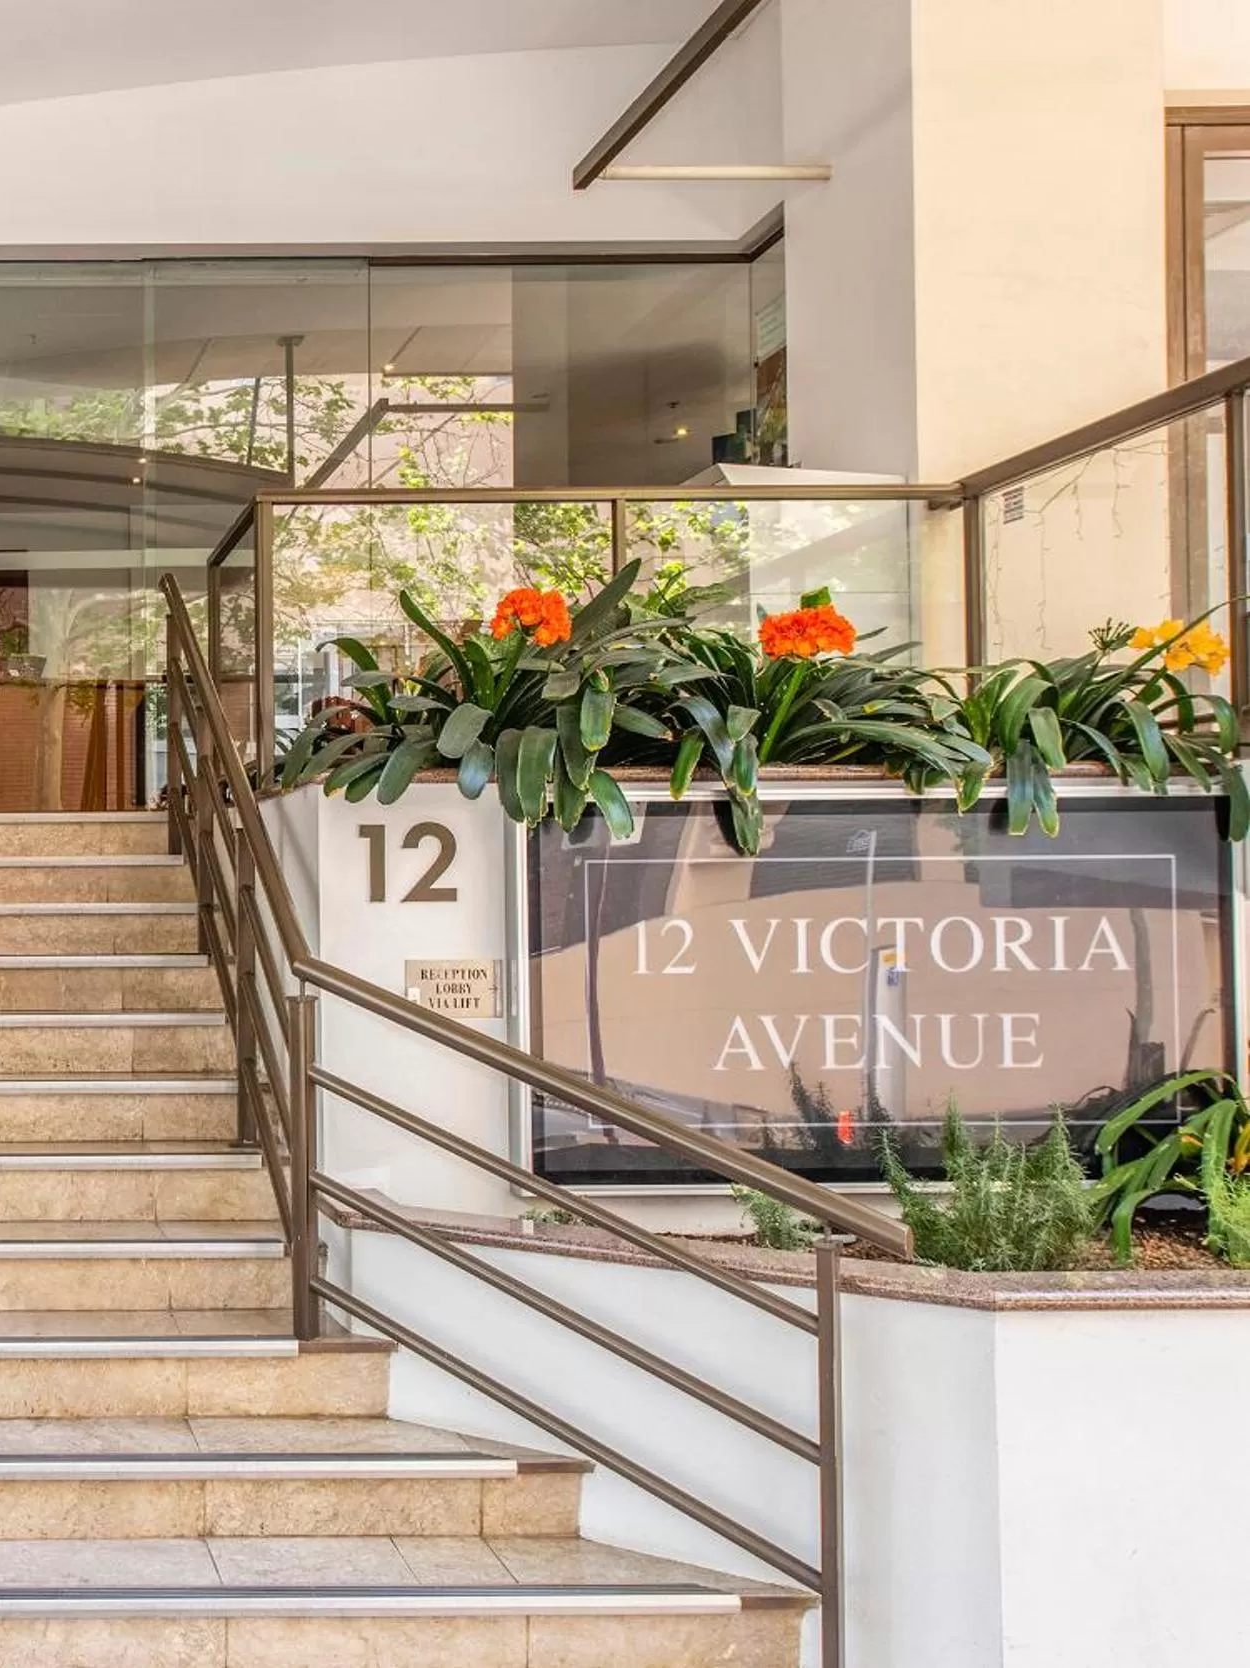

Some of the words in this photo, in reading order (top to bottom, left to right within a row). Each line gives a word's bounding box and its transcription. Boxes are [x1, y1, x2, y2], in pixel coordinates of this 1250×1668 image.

[358, 822, 458, 903] 12
[632, 922, 696, 975] 12
[728, 915, 1132, 974] VICTORIA
[421, 968, 488, 981] RECEPTION
[435, 982, 472, 995] LOBBY
[711, 1014, 1045, 1071] AVENUE
